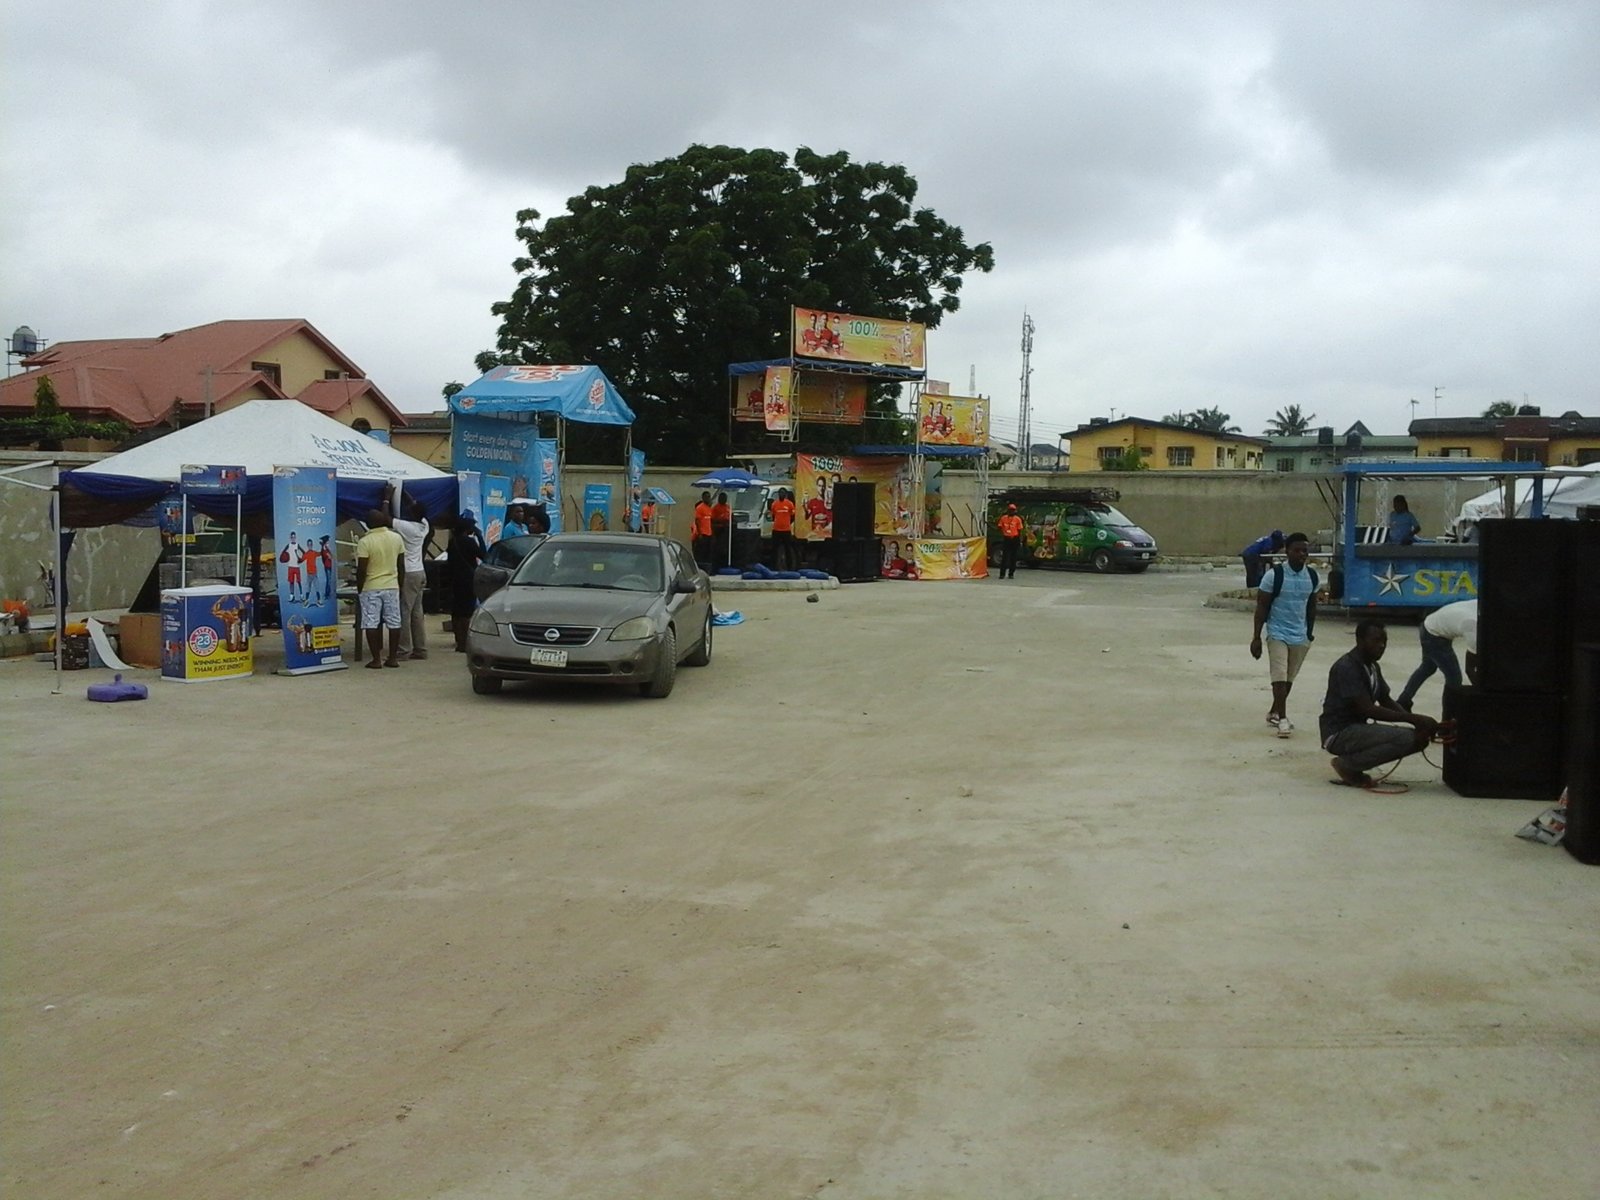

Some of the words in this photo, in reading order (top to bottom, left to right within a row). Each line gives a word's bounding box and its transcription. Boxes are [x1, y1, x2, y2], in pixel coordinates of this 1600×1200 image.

[848, 320, 880, 337] 100%
[463, 431, 479, 443] Start
[479, 435, 496, 448] every
[296, 495, 313, 504] TALL
[296, 506, 326, 515] STRONG
[296, 517, 321, 526] SHARP
[197, 635, 211, 646] 23
